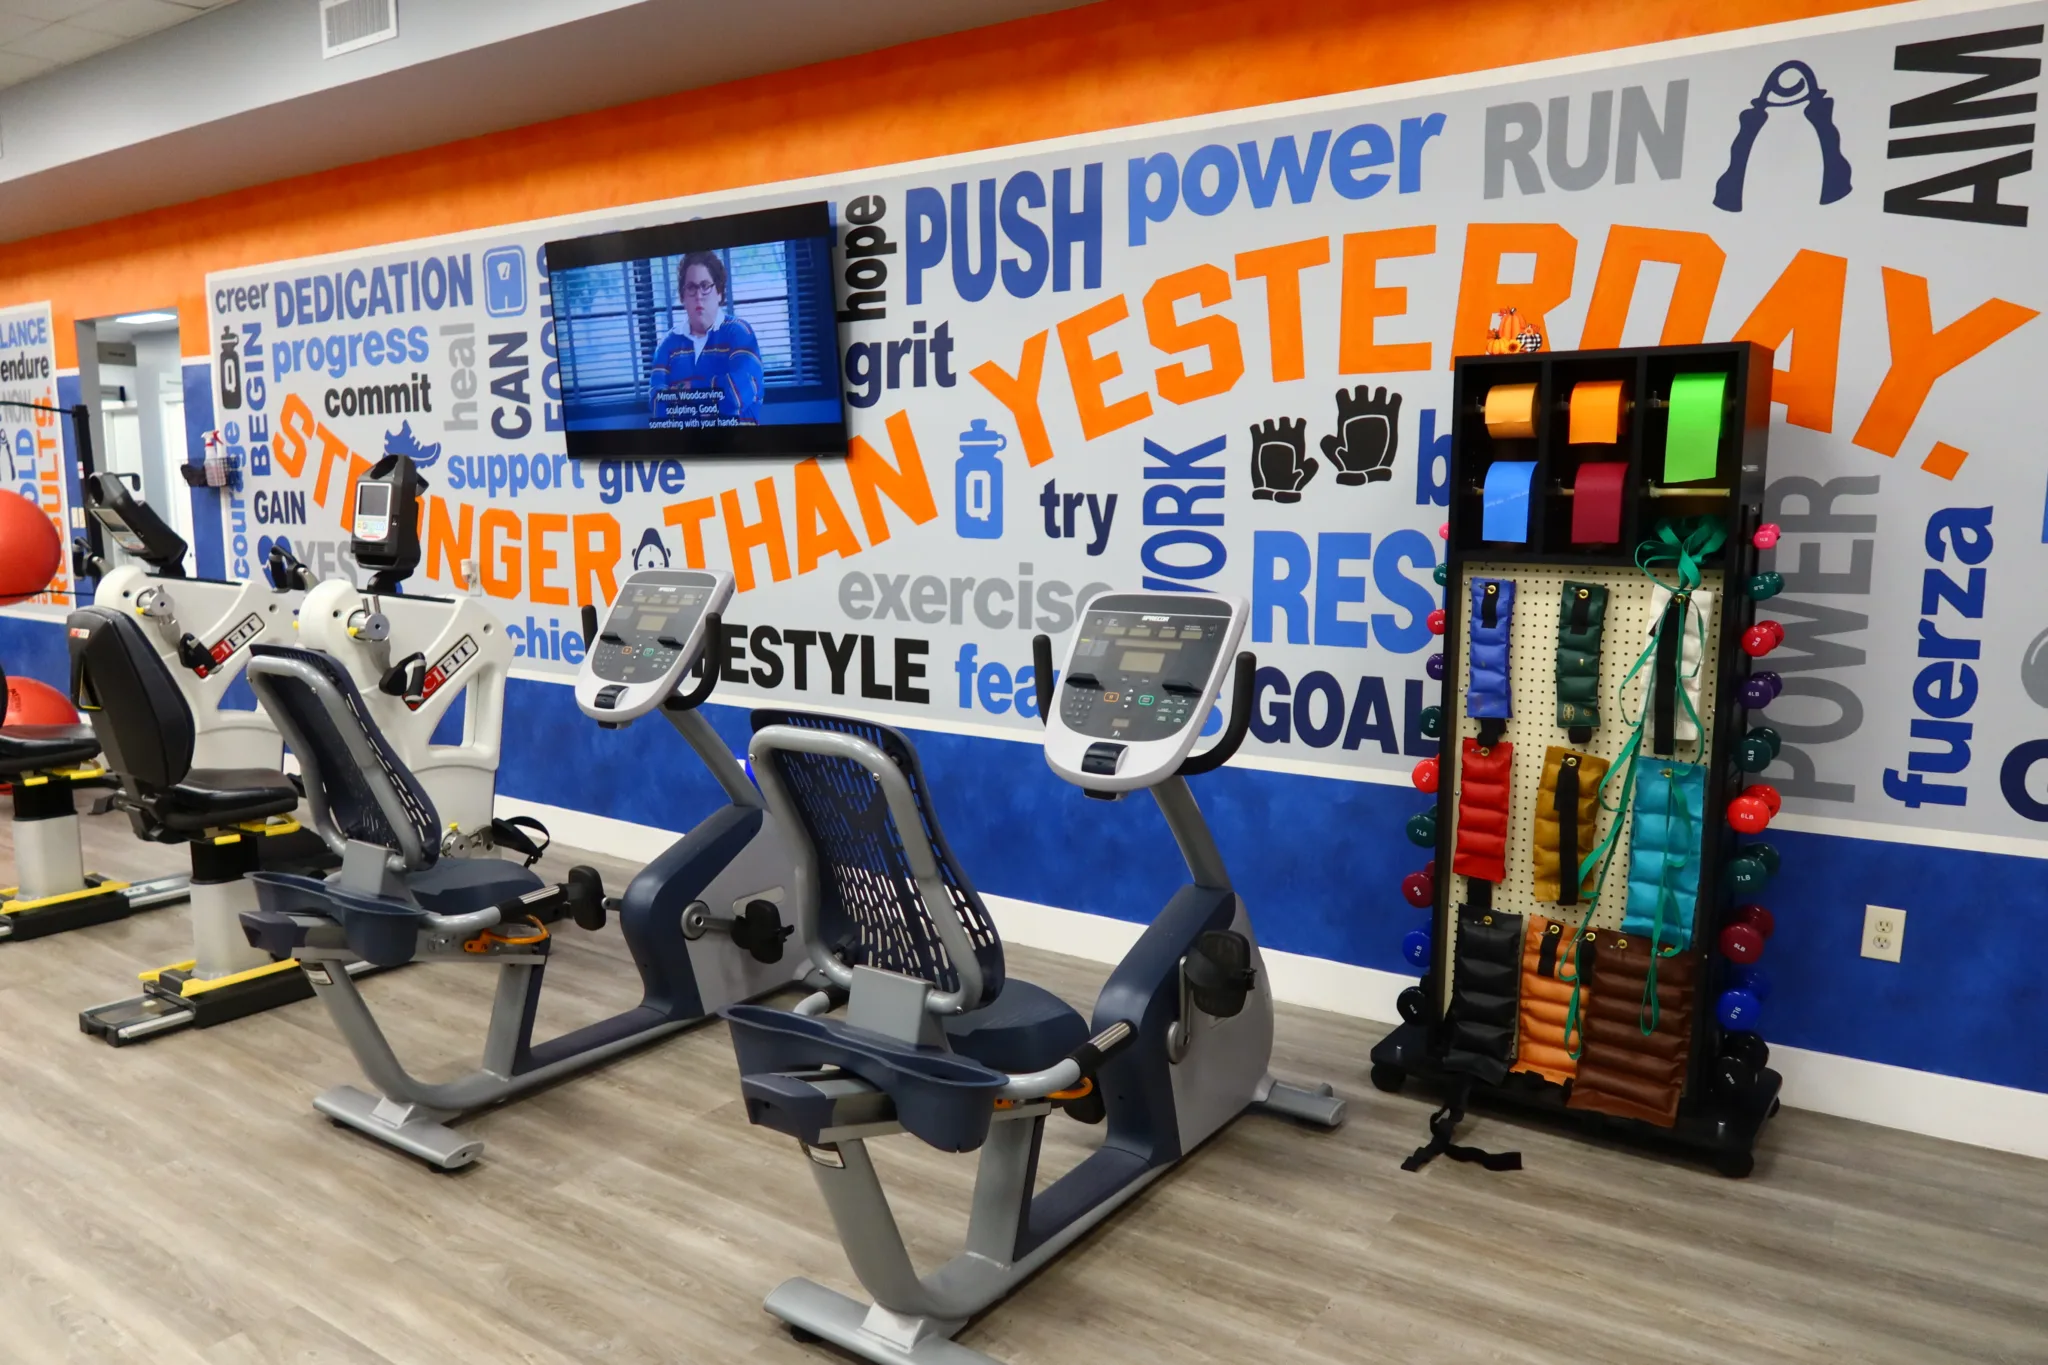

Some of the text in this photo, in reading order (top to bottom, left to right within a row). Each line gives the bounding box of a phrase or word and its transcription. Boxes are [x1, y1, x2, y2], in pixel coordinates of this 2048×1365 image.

[1484, 78, 1690, 200] RUN
[1884, 24, 2045, 227] AIM
[1128, 112, 1448, 247] power
[838, 194, 897, 322] hope
[905, 162, 1103, 305] PUSH
[215, 282, 270, 315] creer
[273, 253, 473, 328] DEDICATION
[0, 351, 49, 382] endure
[272, 325, 430, 383] progress
[440, 322, 478, 432] heal
[489, 331, 532, 439] CAN
[844, 320, 957, 409] grit
[242, 322, 271, 476] BEGIN
[324, 372, 432, 418] commit
[649, 419, 683, 430] something
[684, 418, 700, 428] with
[700, 419, 717, 430] your
[663, 409, 939, 594] THAN
[969, 222, 2040, 481] YESTERDAY.
[16, 428, 40, 507] OLD
[447, 452, 584, 498] support
[599, 459, 685, 504] give
[254, 490, 306, 525] GAIN
[1040, 478, 1118, 556] try
[294, 540, 358, 592] YES
[418, 641, 472, 693] CIFIT
[506, 616, 585, 665] chie
[1747, 474, 1881, 803] POWER
[1883, 505, 1994, 808] fuerza
[1415, 828, 1428, 838] 7LB
[1733, 942, 1746, 952] 8LB
[1730, 1007, 1741, 1019] 9LB
